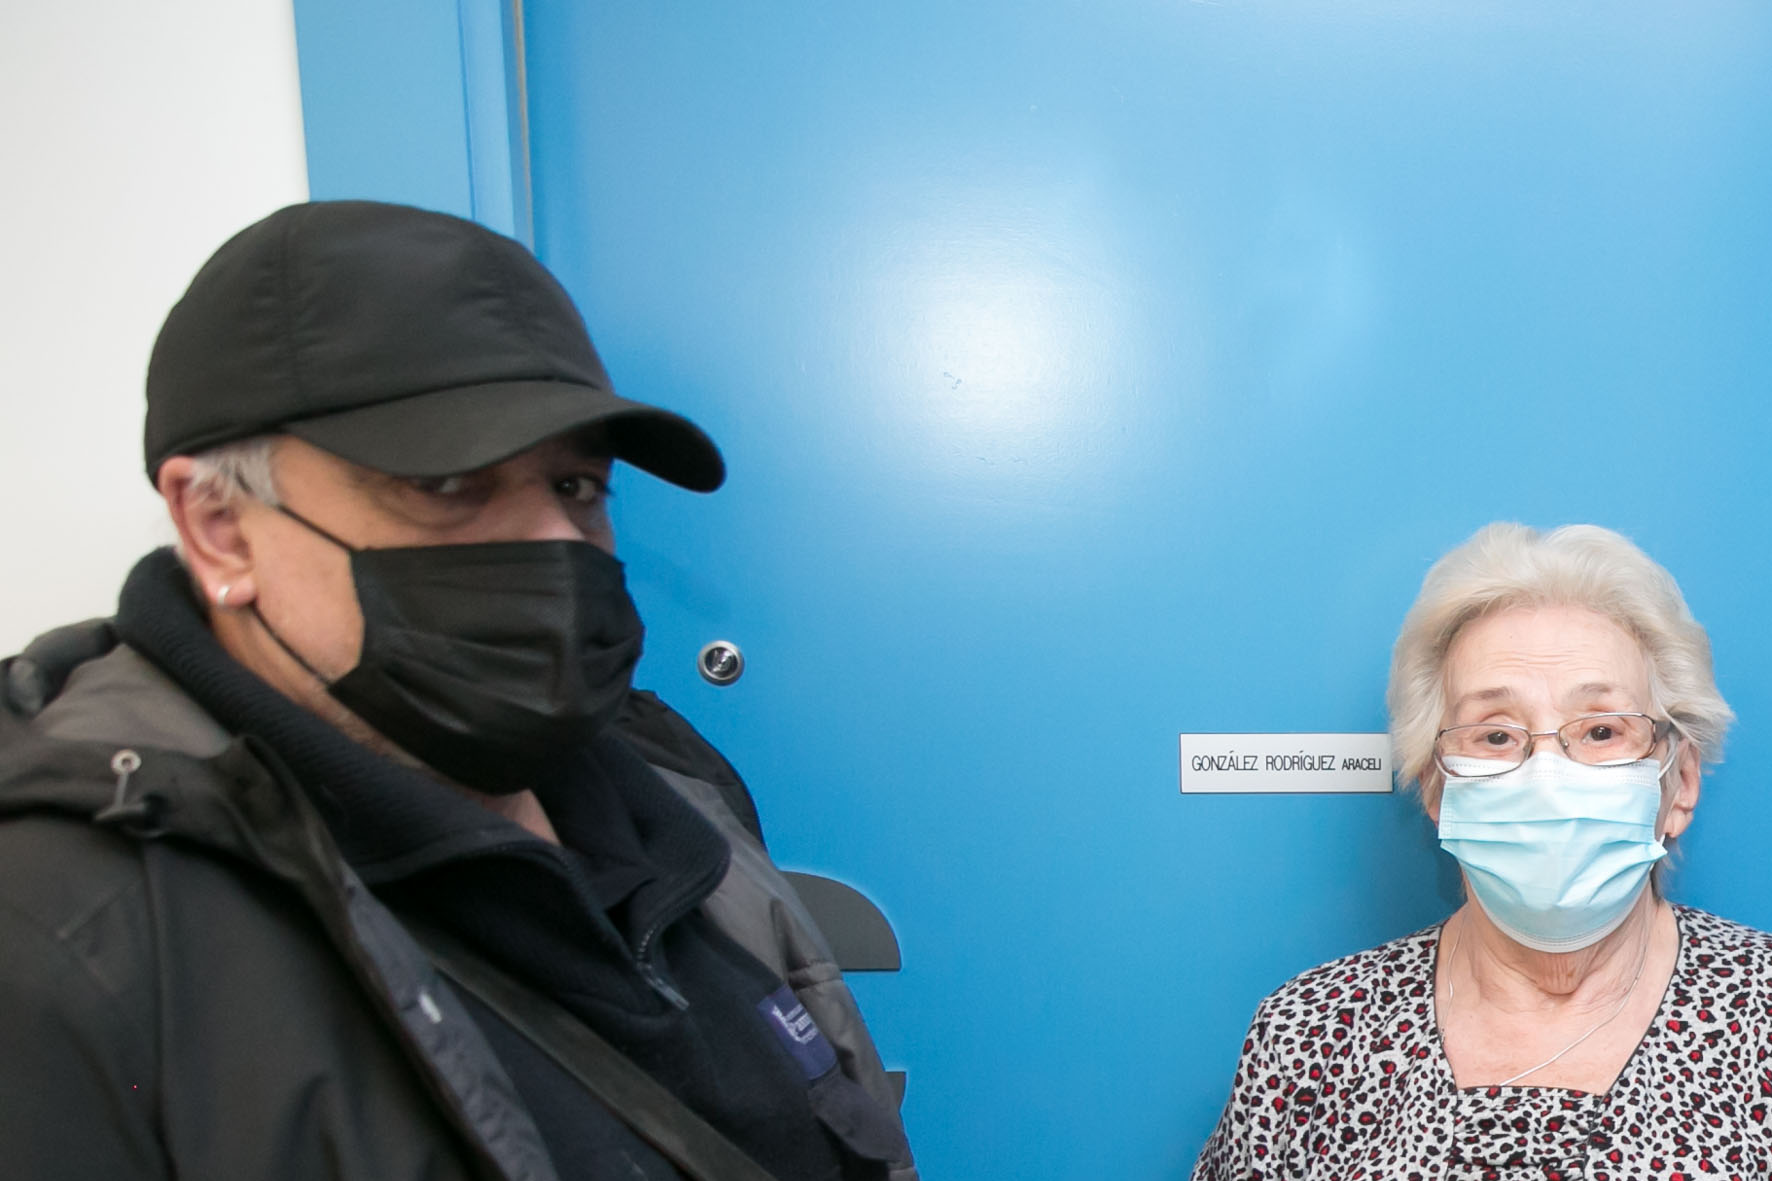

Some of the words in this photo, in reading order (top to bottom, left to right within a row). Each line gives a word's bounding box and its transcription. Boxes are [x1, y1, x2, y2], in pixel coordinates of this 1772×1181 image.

[1191, 750, 1258, 771] GONZÁLEZ
[1265, 750, 1335, 771] RODRÍGUEZ
[1341, 758, 1382, 771] ARACELI
